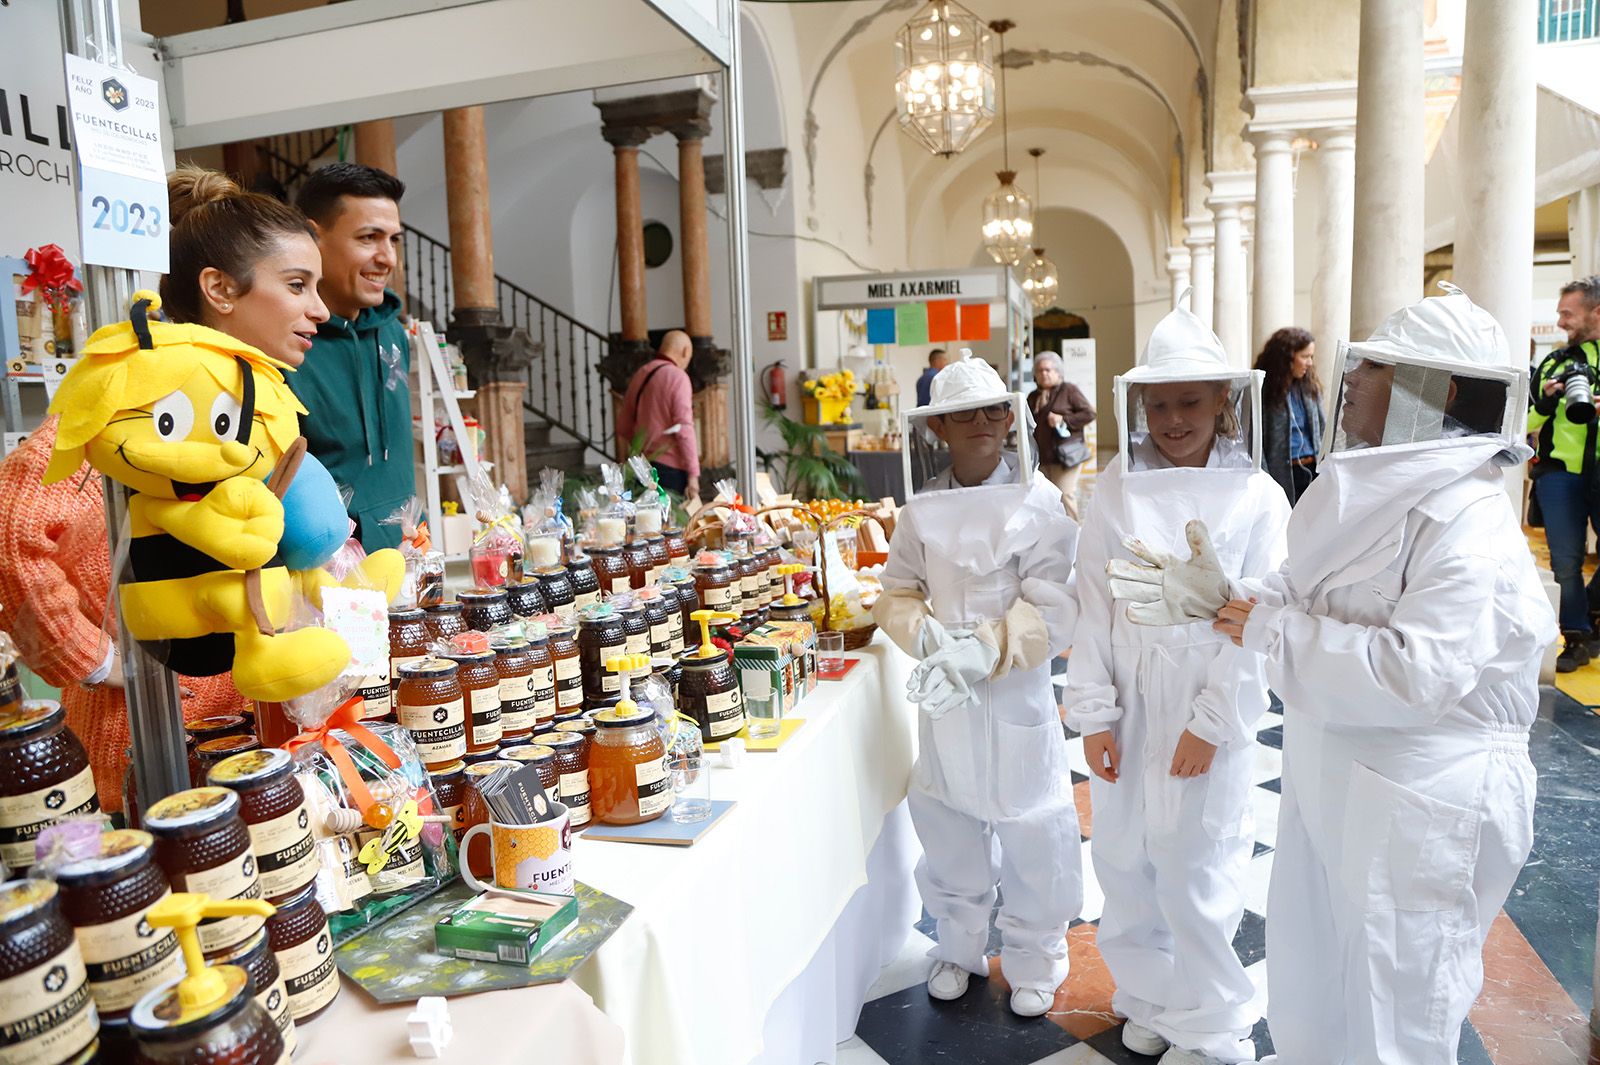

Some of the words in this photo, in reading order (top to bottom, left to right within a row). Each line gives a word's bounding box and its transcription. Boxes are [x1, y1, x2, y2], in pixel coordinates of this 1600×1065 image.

[135, 97, 155, 110] 2023
[75, 112, 158, 142] FUENTECILLAS
[92, 195, 161, 238] 2023
[867, 282, 895, 298] MIEL
[899, 279, 962, 297] AXARMIEL
